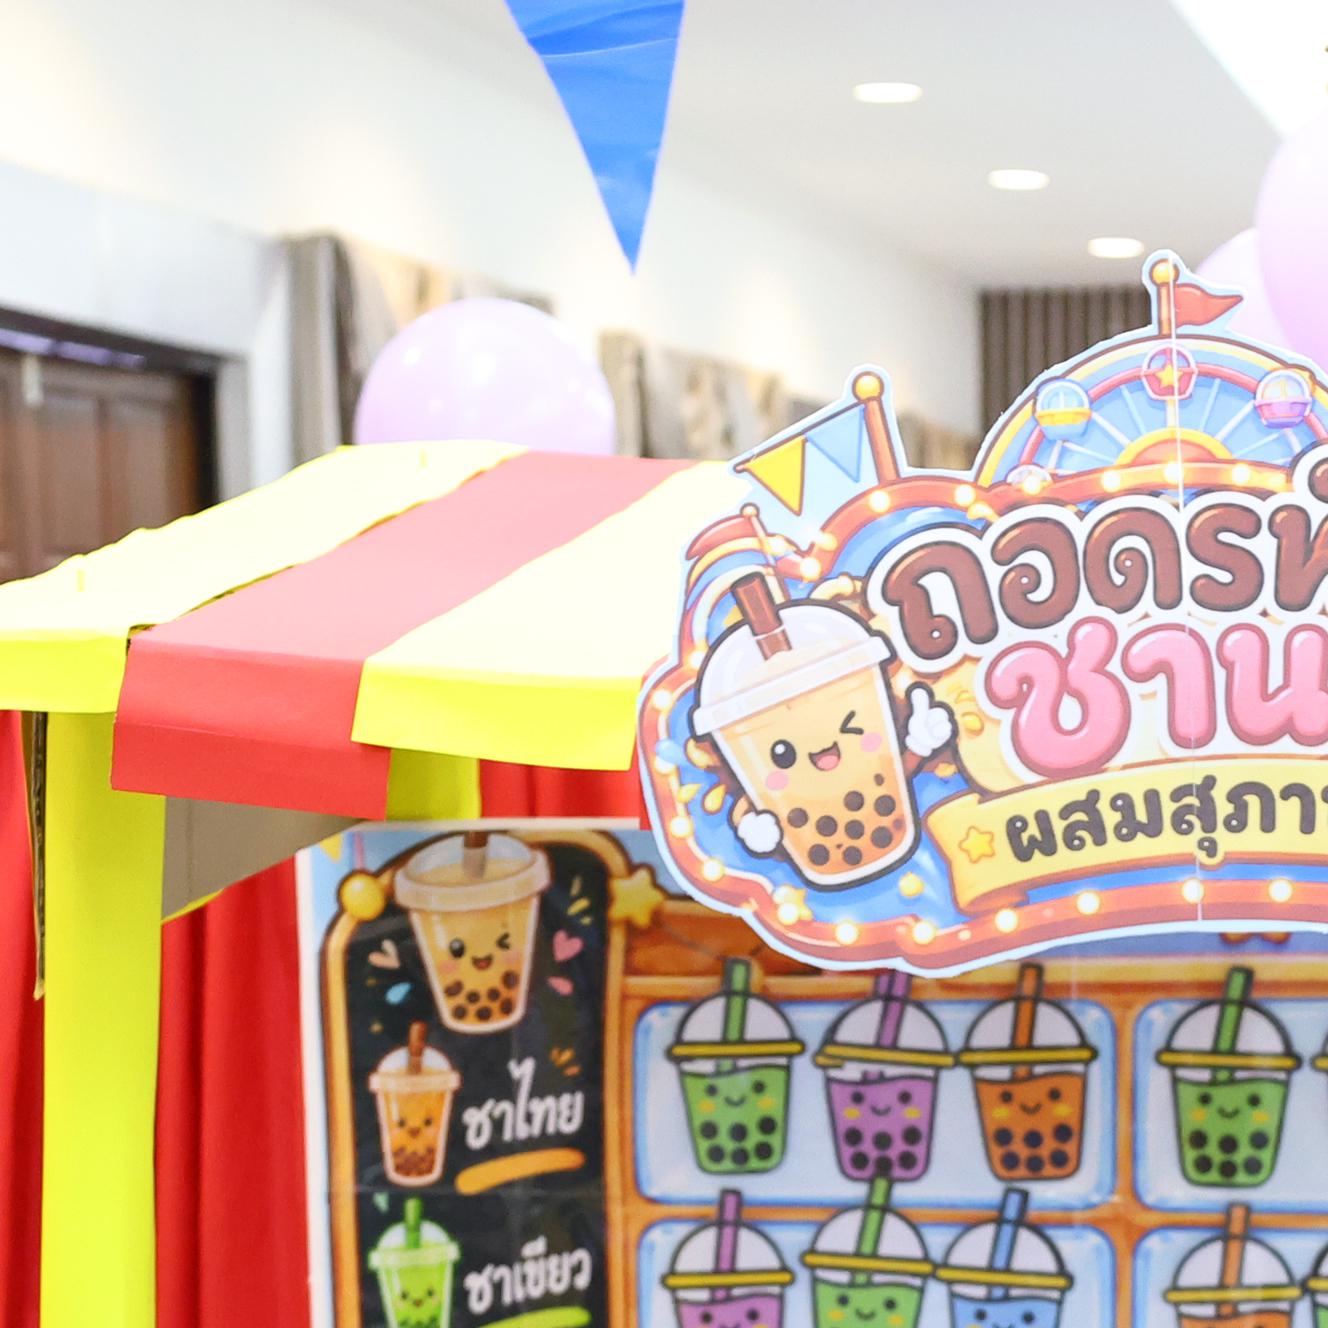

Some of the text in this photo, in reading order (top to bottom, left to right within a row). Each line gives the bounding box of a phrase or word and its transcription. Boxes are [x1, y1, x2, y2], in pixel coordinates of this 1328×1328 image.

[462, 1056, 584, 1149] ชาไทย
[463, 1235, 592, 1315] ชาเขียว
